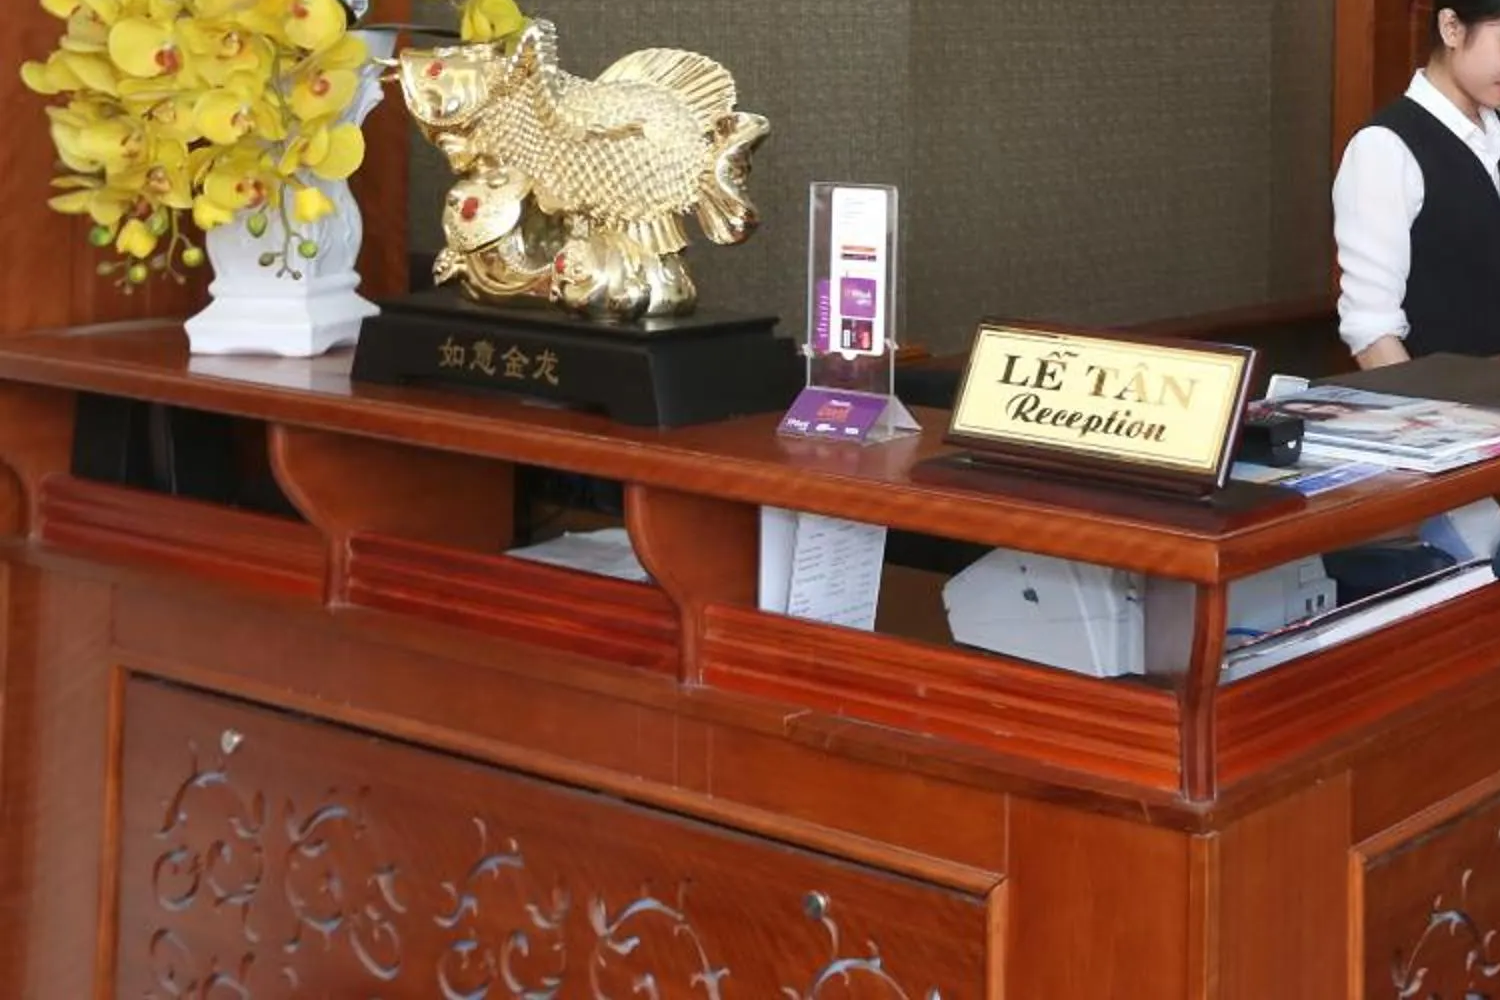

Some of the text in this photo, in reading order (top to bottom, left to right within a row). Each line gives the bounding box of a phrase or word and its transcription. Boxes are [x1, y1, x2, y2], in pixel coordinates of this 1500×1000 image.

[997, 350, 1200, 410] LỄ TÂN
[1005, 392, 1167, 443] Reception
